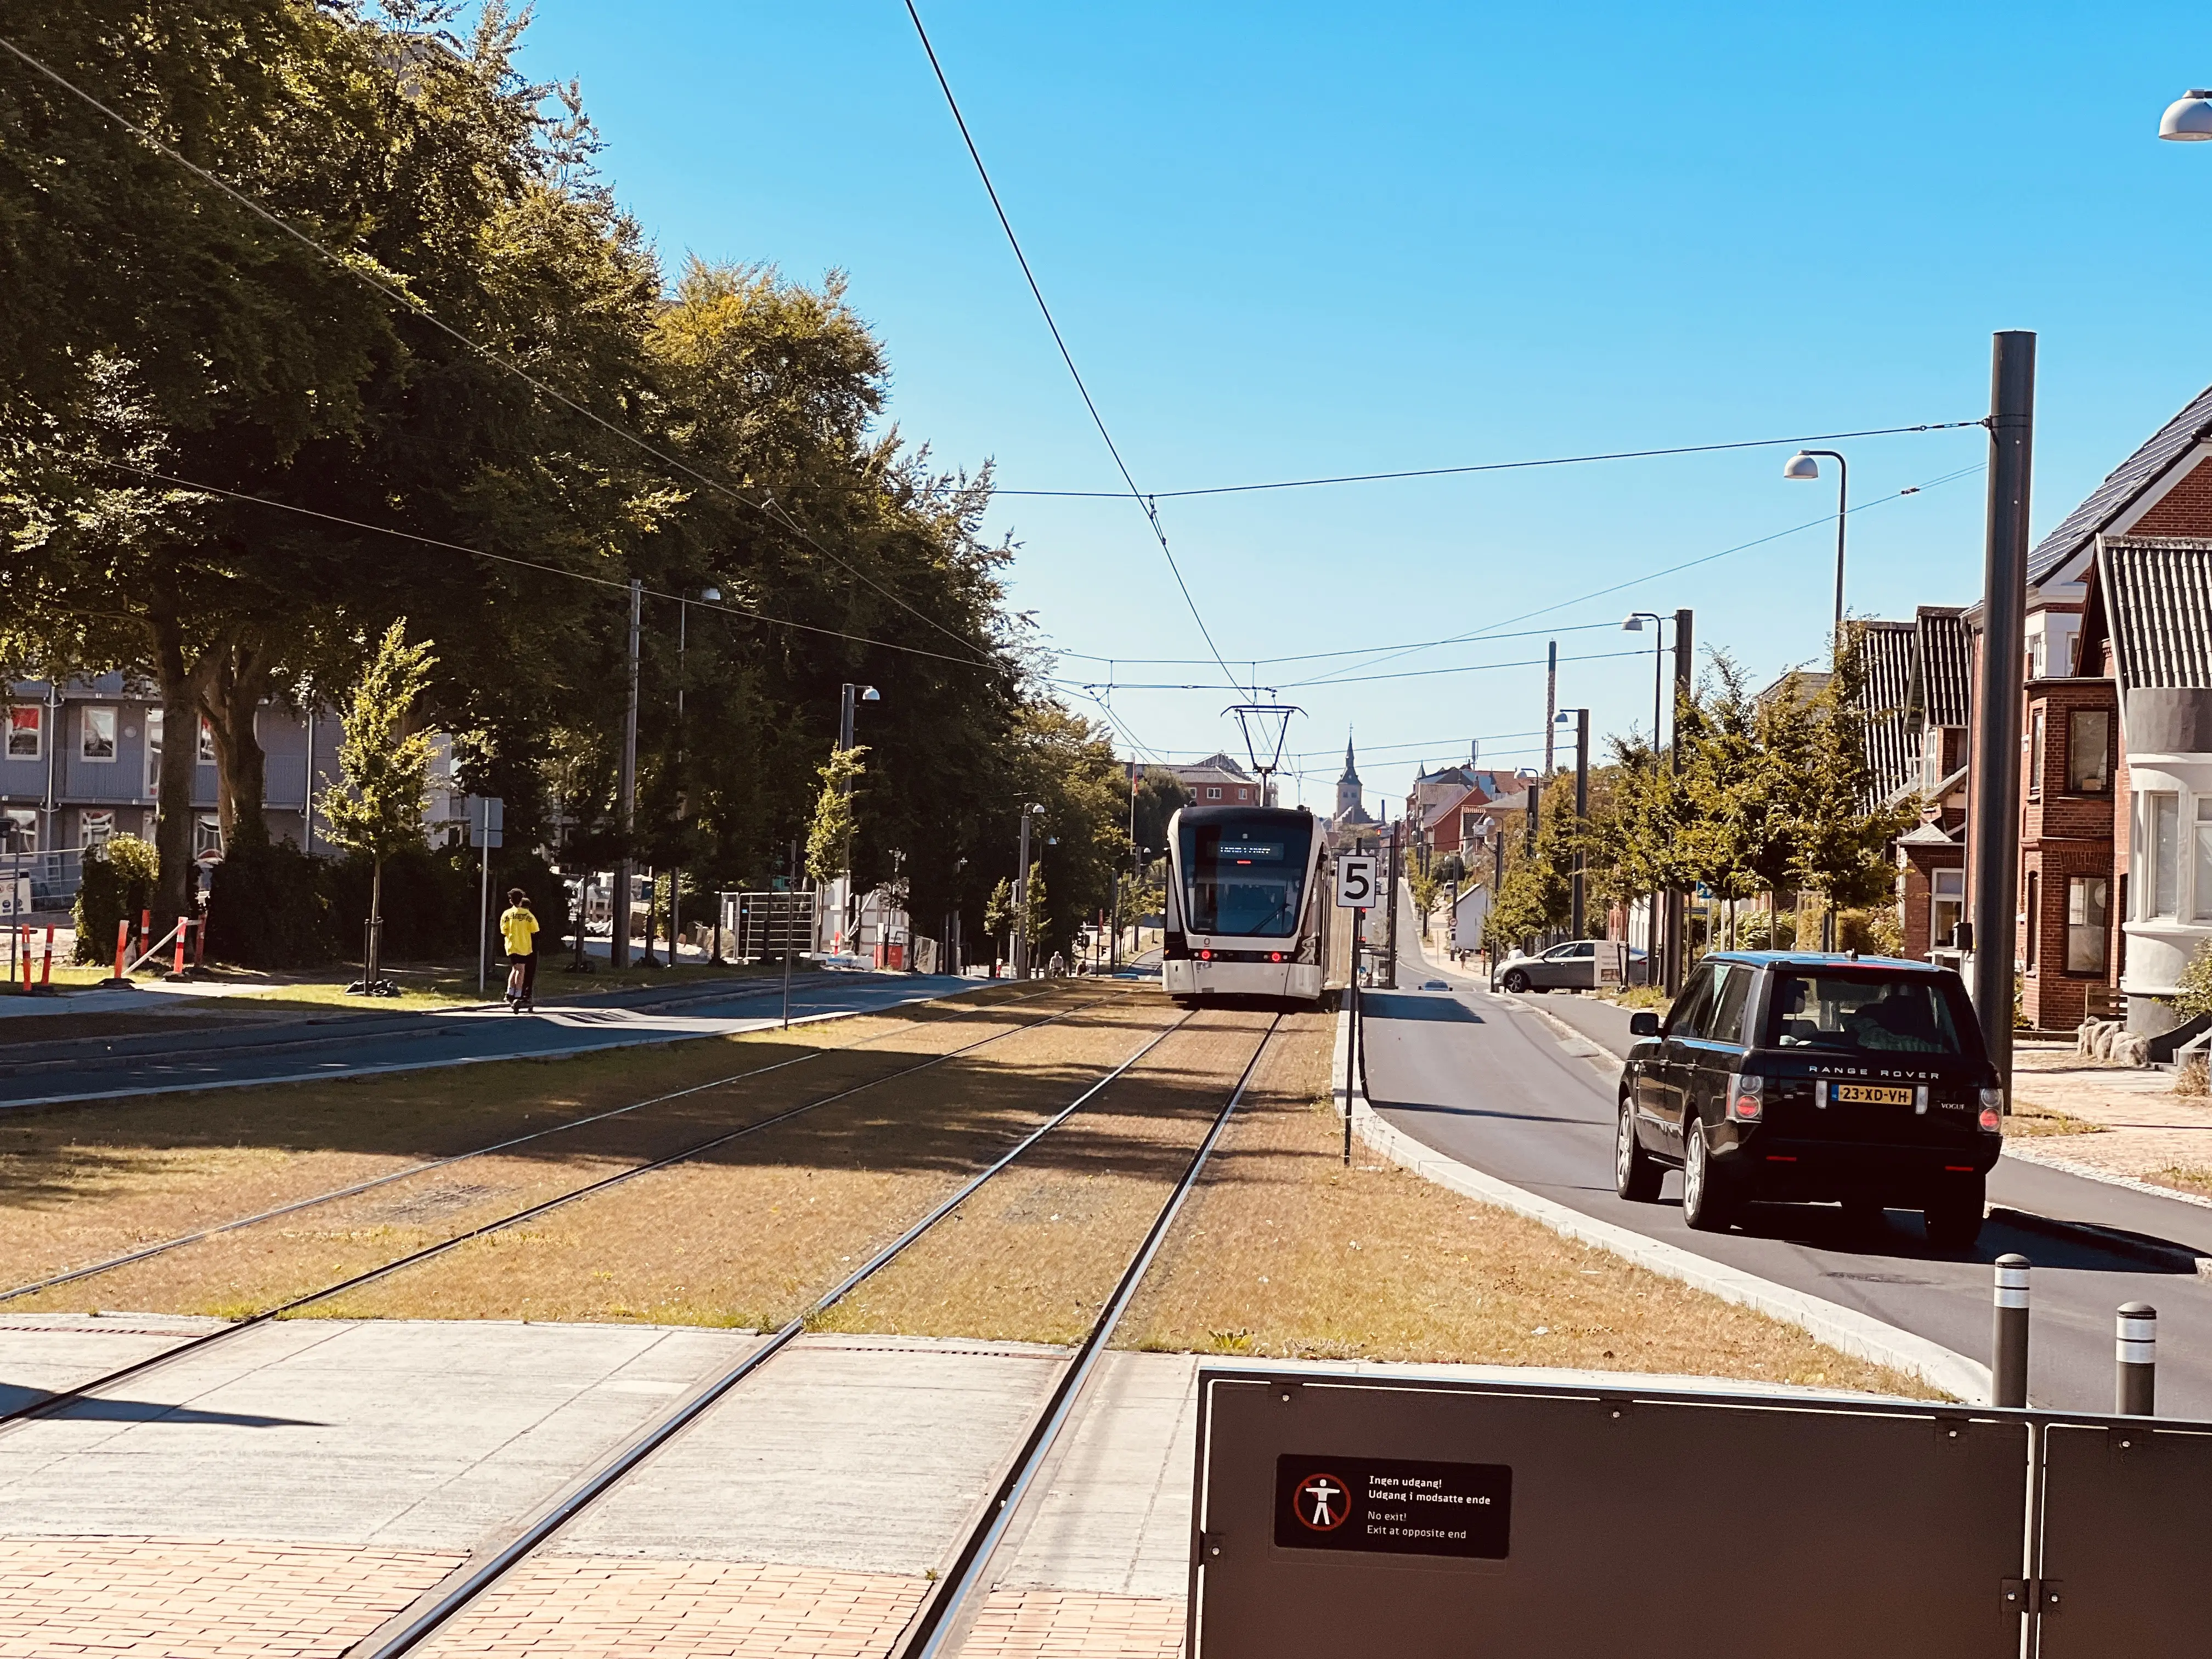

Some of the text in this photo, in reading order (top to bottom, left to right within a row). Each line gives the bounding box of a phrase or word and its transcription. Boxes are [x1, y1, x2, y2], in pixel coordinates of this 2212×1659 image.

[1344, 863, 1369, 900] 5
[1809, 1066, 1938, 1079] RANGE ROVER
[1843, 1087, 1907, 1103] 23-XD-VH
[1369, 1476, 1441, 1489] Ingen udgang!
[1369, 1490, 1491, 1505] Udgang i modsatte ende
[1368, 1510, 1407, 1521] No exit!
[1367, 1525, 1386, 1534] Exit
[1402, 1528, 1445, 1538] opposite
[1448, 1530, 1466, 1539] end
